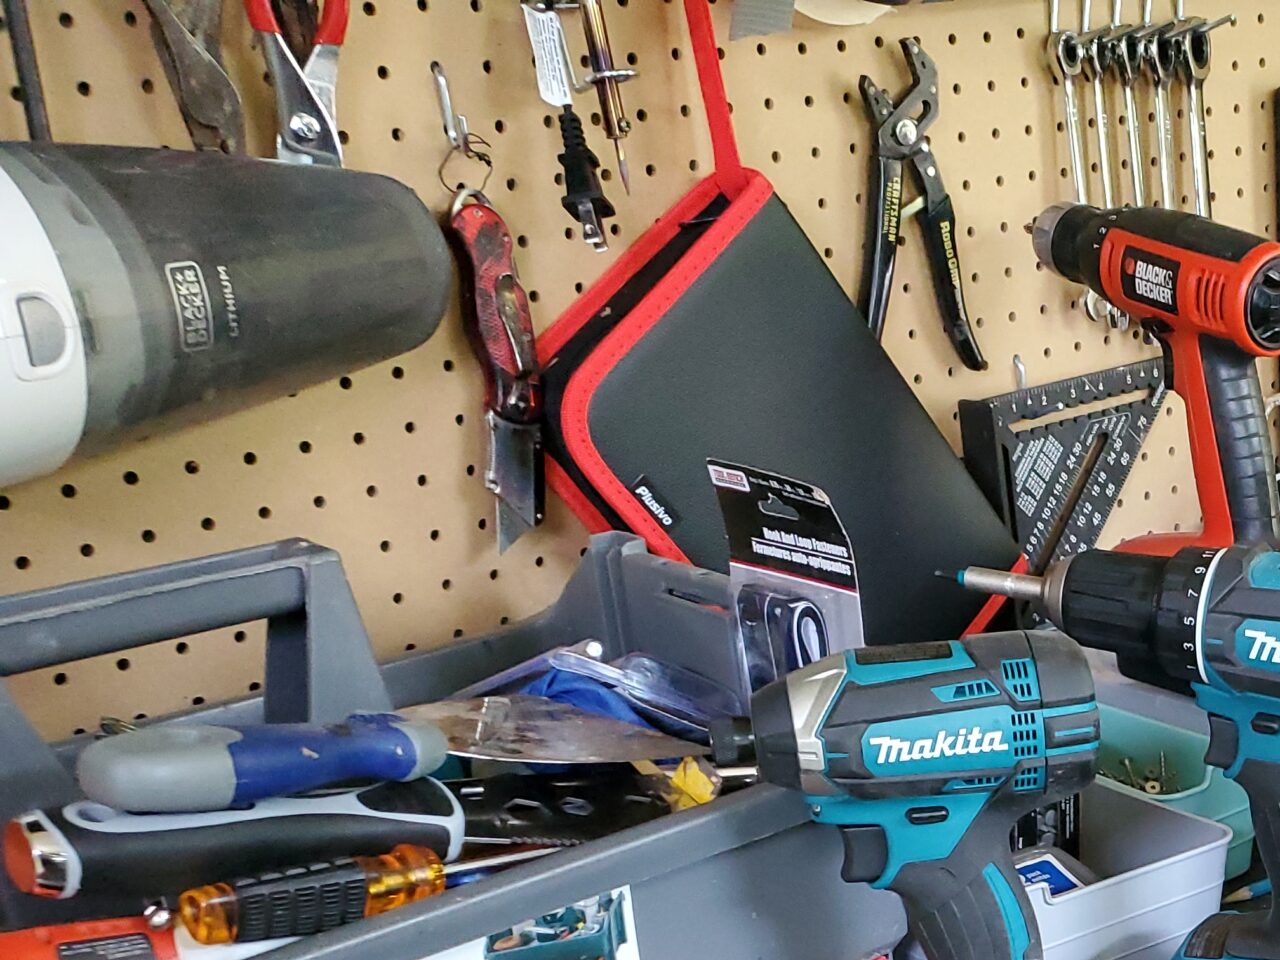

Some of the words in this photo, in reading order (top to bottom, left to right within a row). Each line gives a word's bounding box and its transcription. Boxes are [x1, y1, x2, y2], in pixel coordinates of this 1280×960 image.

[887, 176, 901, 242] CRAFTSMAN
[217, 266, 239, 337] LITHIUM
[1135, 278, 1173, 305] DECKER
[1041, 396, 1048, 406] 2
[1070, 389, 1076, 399] 3
[1126, 374, 1132, 385] 5
[1153, 368, 1159, 378] 6
[1033, 528, 1041, 537] 7
[1041, 508, 1051, 520] 10
[1047, 496, 1057, 509] 12
[1066, 454, 1077, 470] 24
[1073, 442, 1082, 456] 30
[1077, 516, 1087, 527] 10
[1083, 501, 1093, 515] 12
[1106, 451, 1117, 466] 24
[1113, 438, 1123, 451] 30
[1092, 512, 1102, 526] 45
[1105, 483, 1116, 497] 55
[1120, 451, 1130, 466] 65
[1137, 415, 1147, 429] 75
[635, 486, 672, 525] Plusivo
[1194, 566, 1206, 575] 9
[1187, 588, 1199, 598] 7
[1183, 616, 1195, 626] 5
[1183, 641, 1194, 651] 3
